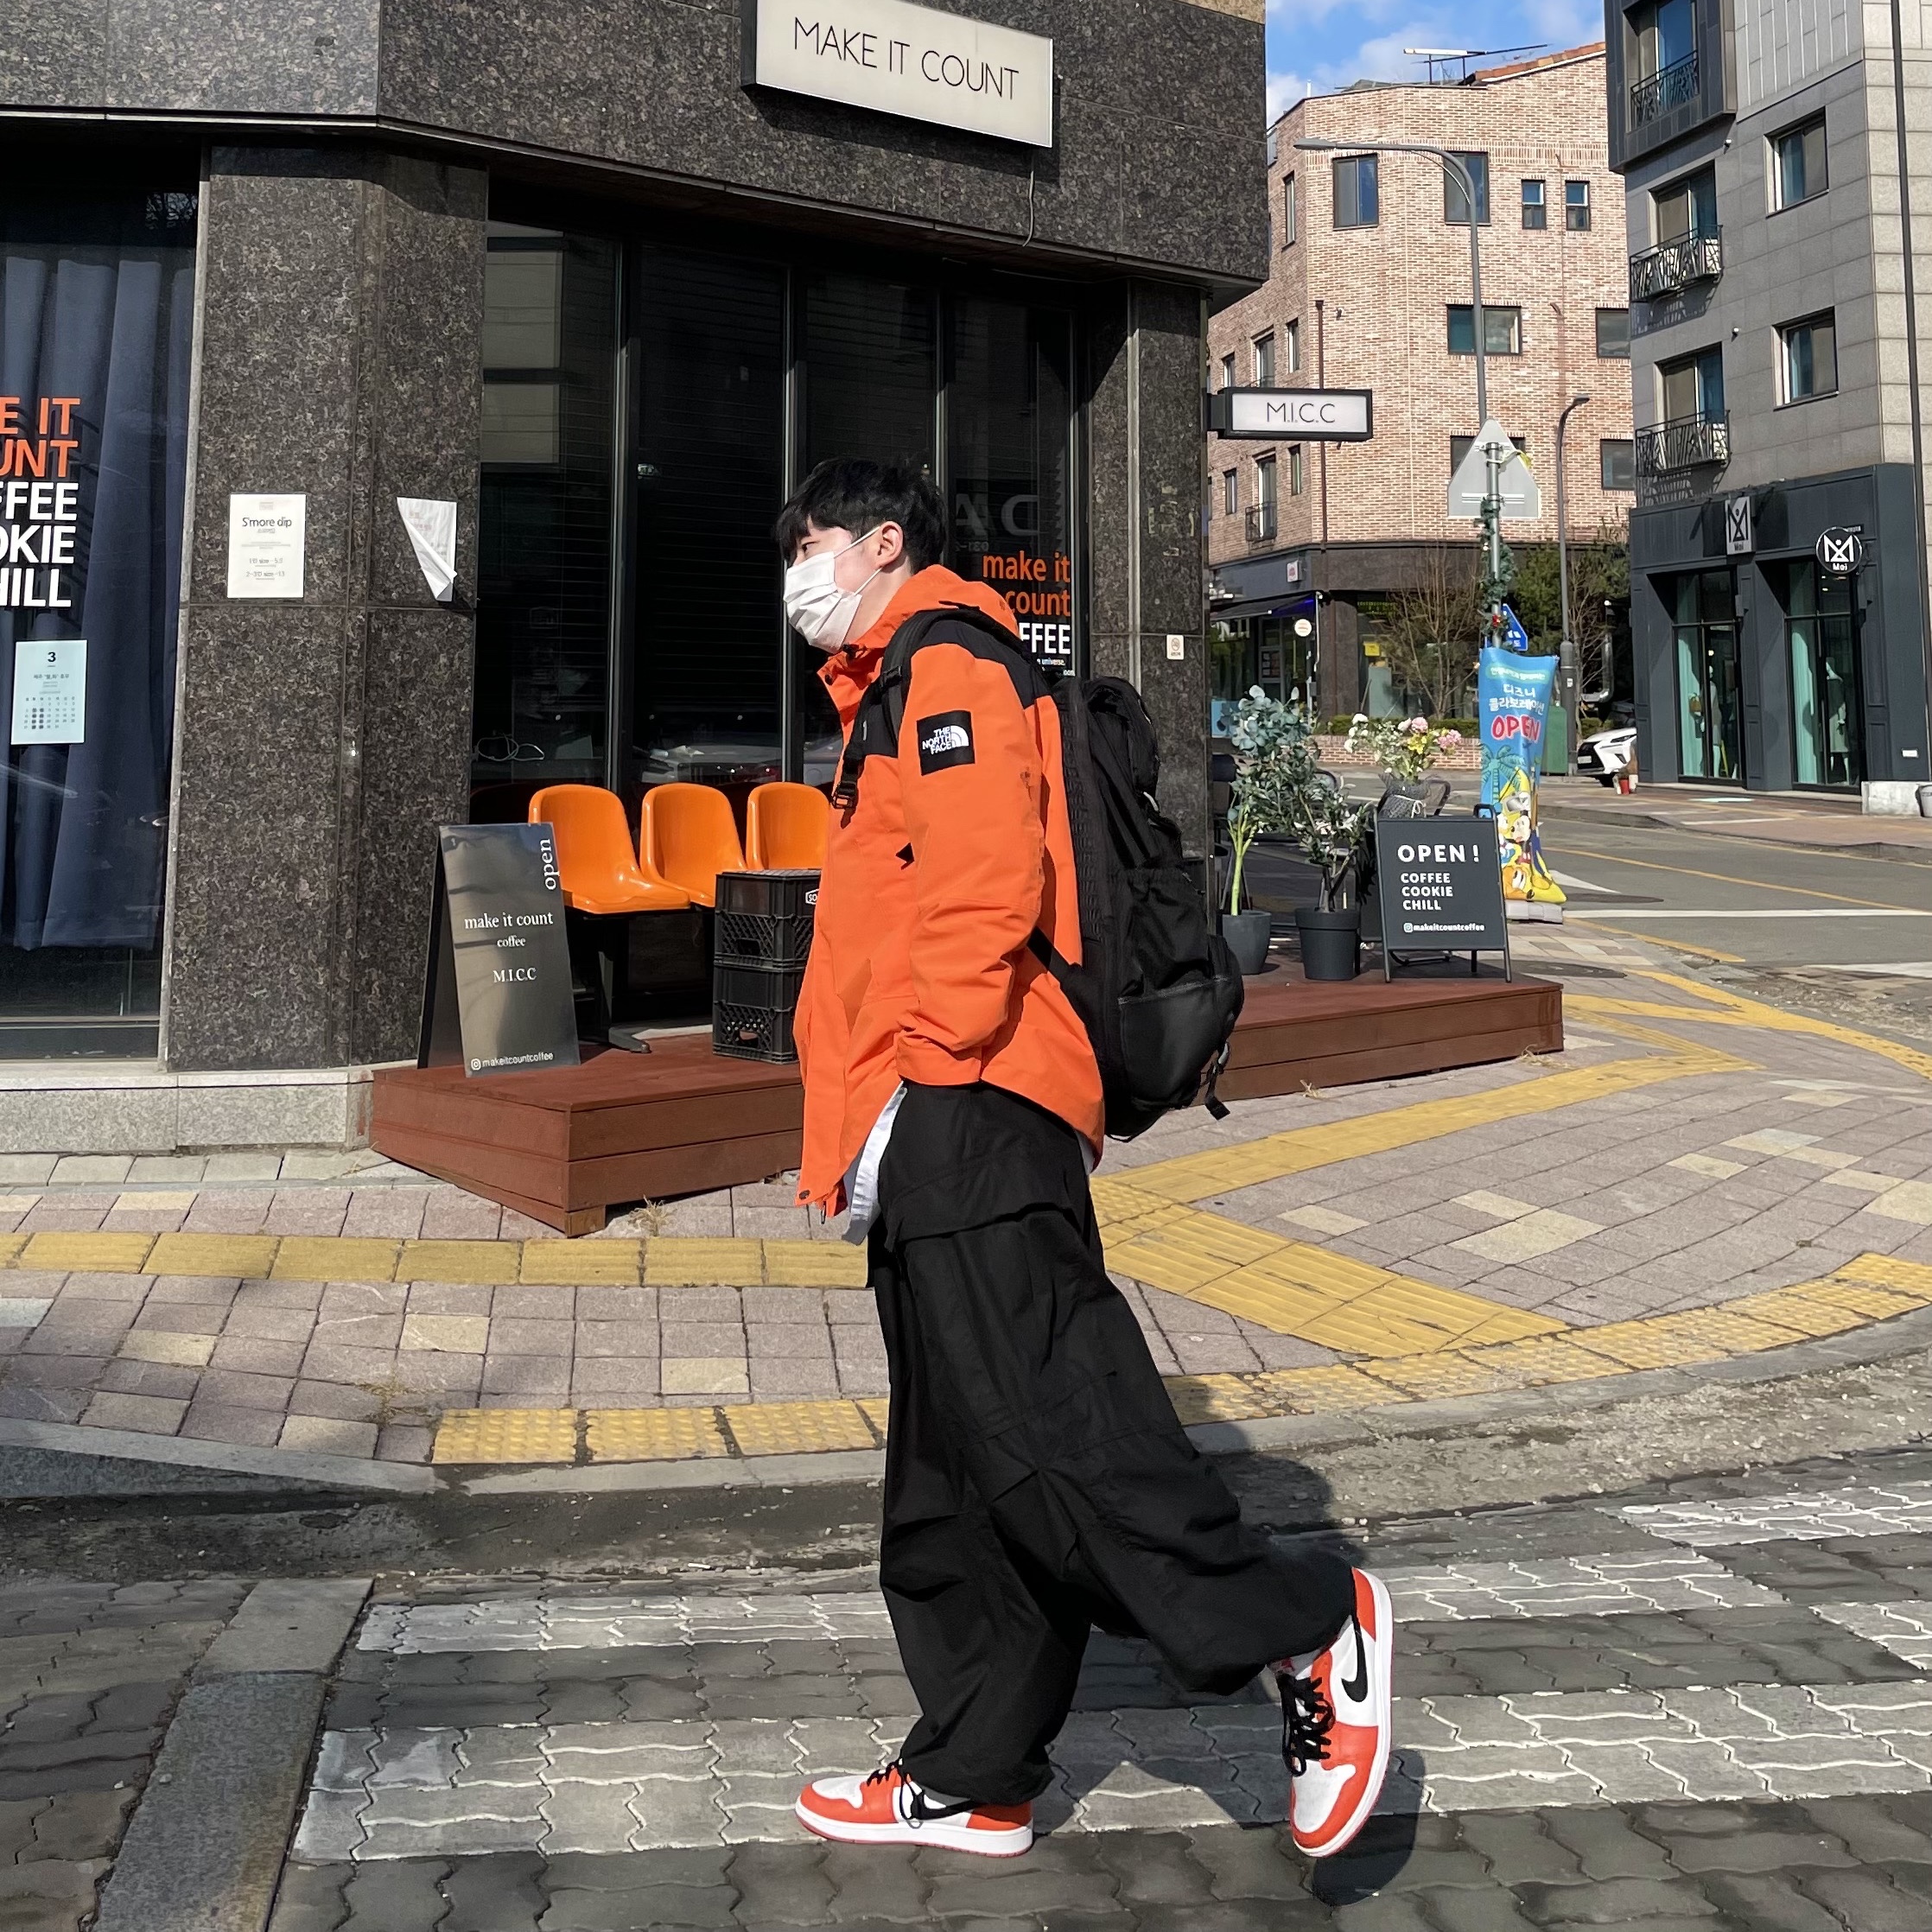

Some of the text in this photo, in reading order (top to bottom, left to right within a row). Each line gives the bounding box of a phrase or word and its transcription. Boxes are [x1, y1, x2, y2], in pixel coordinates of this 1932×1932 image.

[795, 16, 1019, 99] MAKE IT COUNT
[39, 397, 80, 435] IT
[1267, 402, 1335, 423] M.I.C.C
[982, 550, 1071, 583] make it
[1833, 562, 1847, 571] Moi
[1005, 589, 1071, 617] count
[48, 651, 56, 663] 3
[1503, 683, 1535, 697] 디즈니
[1489, 698, 1544, 715] 콜라보레이션
[933, 726, 950, 737] THE
[1491, 715, 1541, 742] OPEN
[922, 733, 950, 750] NORTH
[931, 741, 951, 755] FACE
[1397, 844, 1465, 863] OPEN
[539, 838, 560, 891] open
[1401, 873, 1451, 884] COFFEE
[1401, 886, 1453, 897] COOKIE
[1402, 899, 1441, 911] CHILL
[464, 912, 553, 929] make it count
[497, 935, 526, 948] coffee
